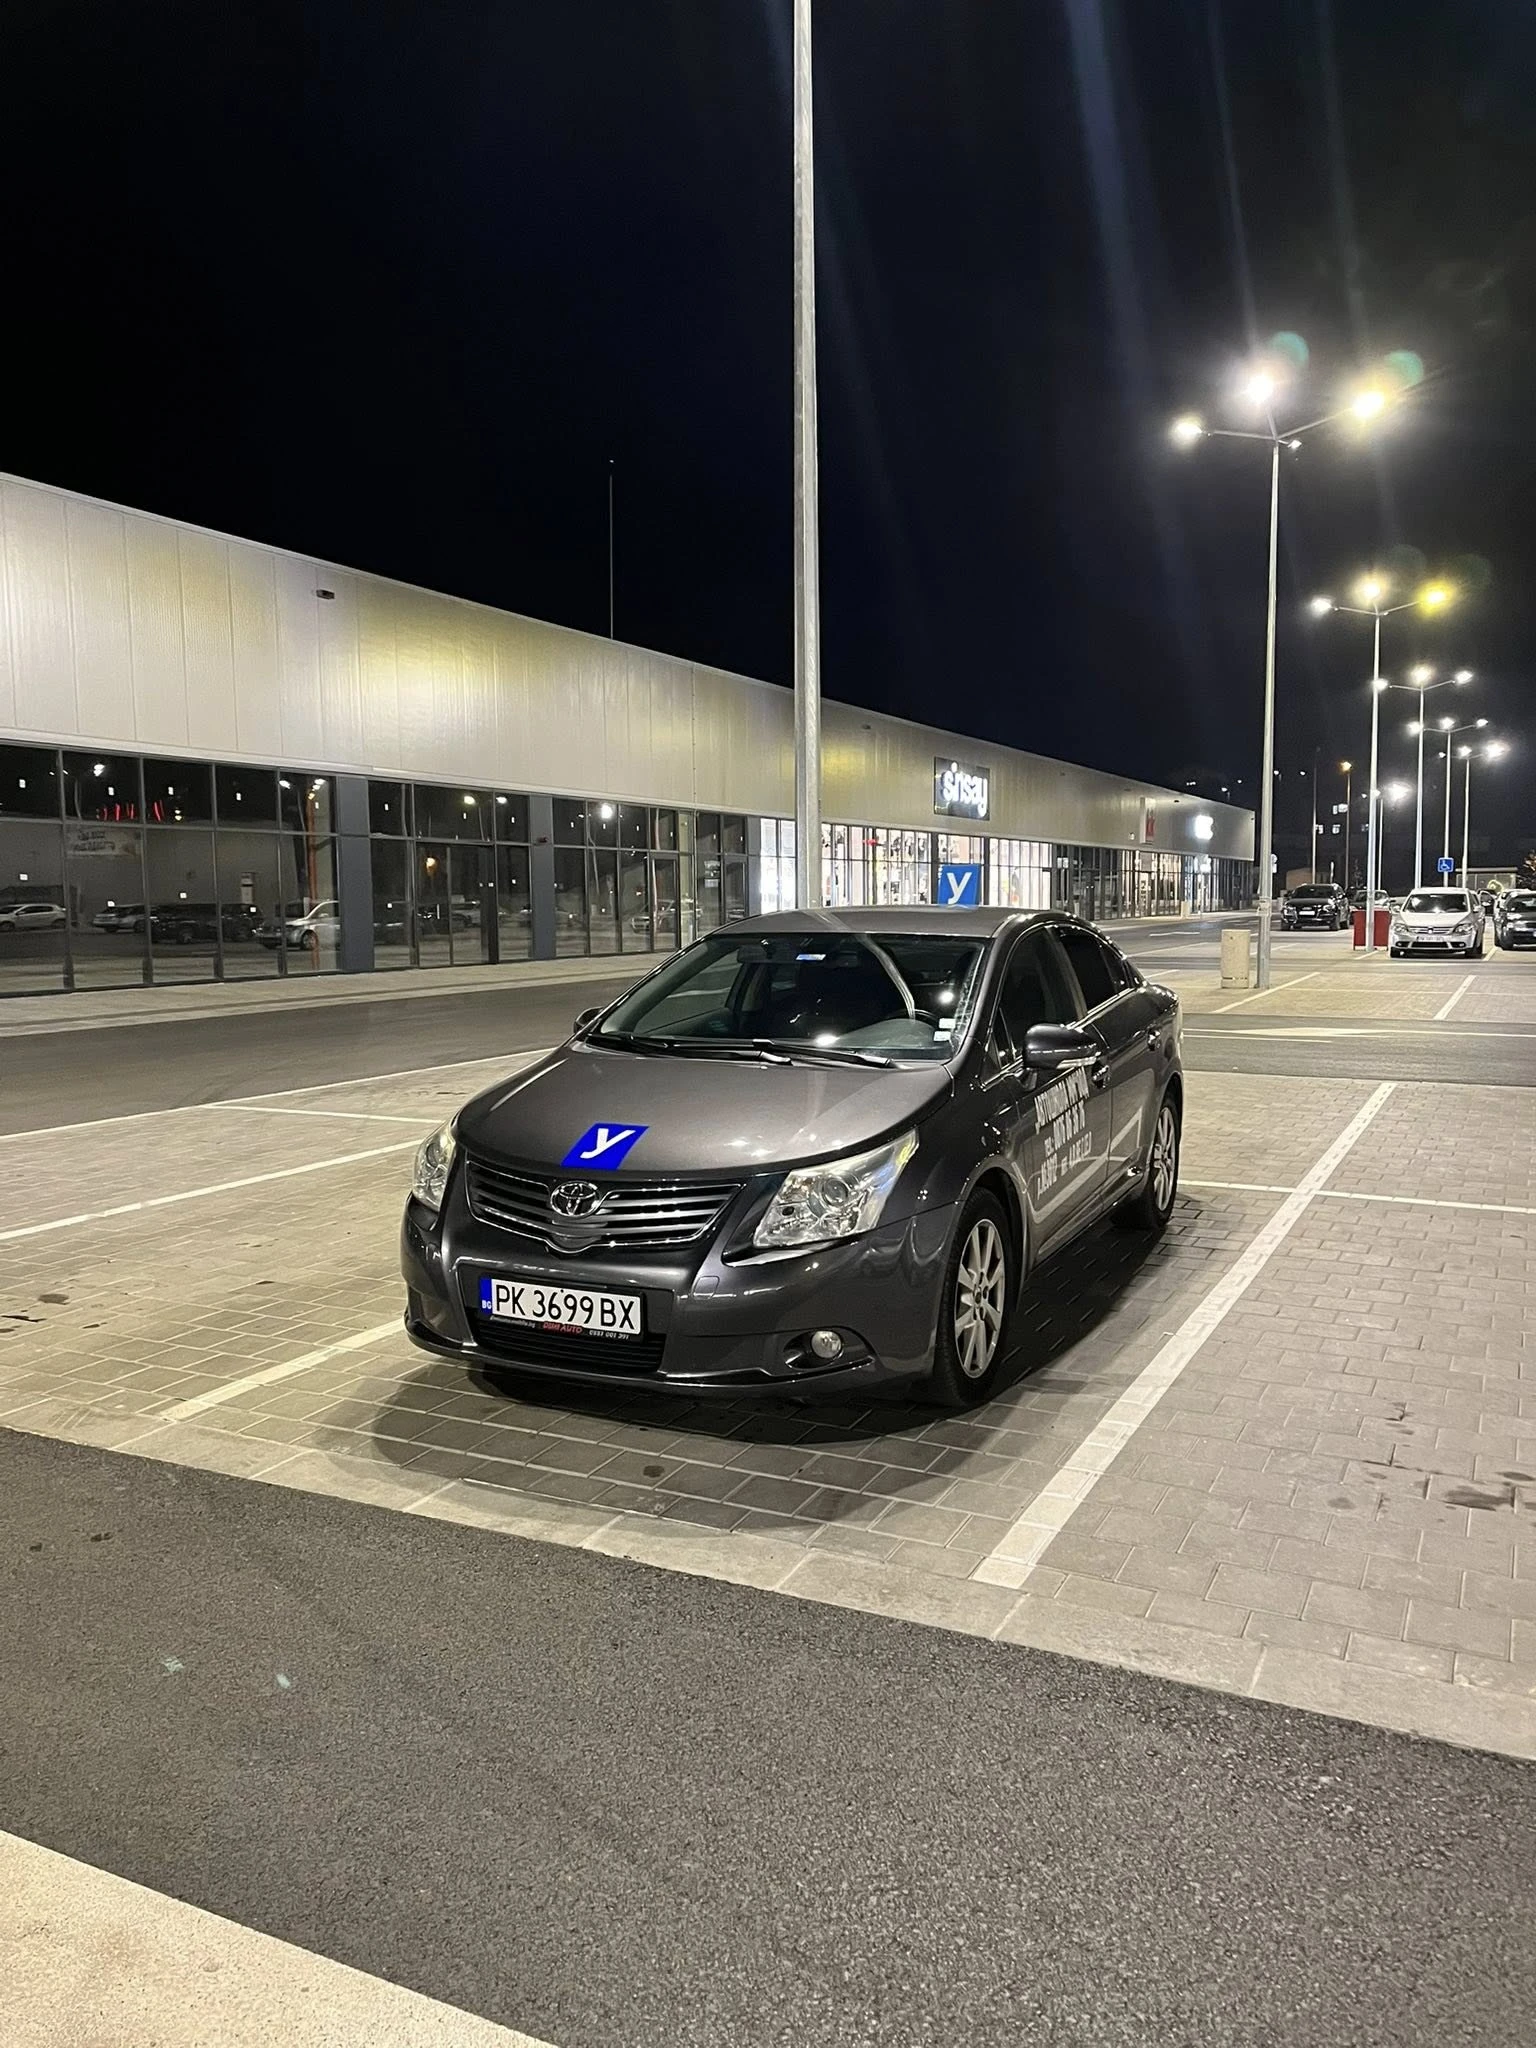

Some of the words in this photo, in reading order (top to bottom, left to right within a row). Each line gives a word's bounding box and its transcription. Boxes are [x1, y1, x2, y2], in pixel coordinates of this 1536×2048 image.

[481, 1300, 492, 1310] BG
[495, 1284, 526, 1316] PK
[532, 1290, 594, 1324] 3699
[600, 1297, 635, 1330] BX
[560, 1324, 583, 1334] AUTO
